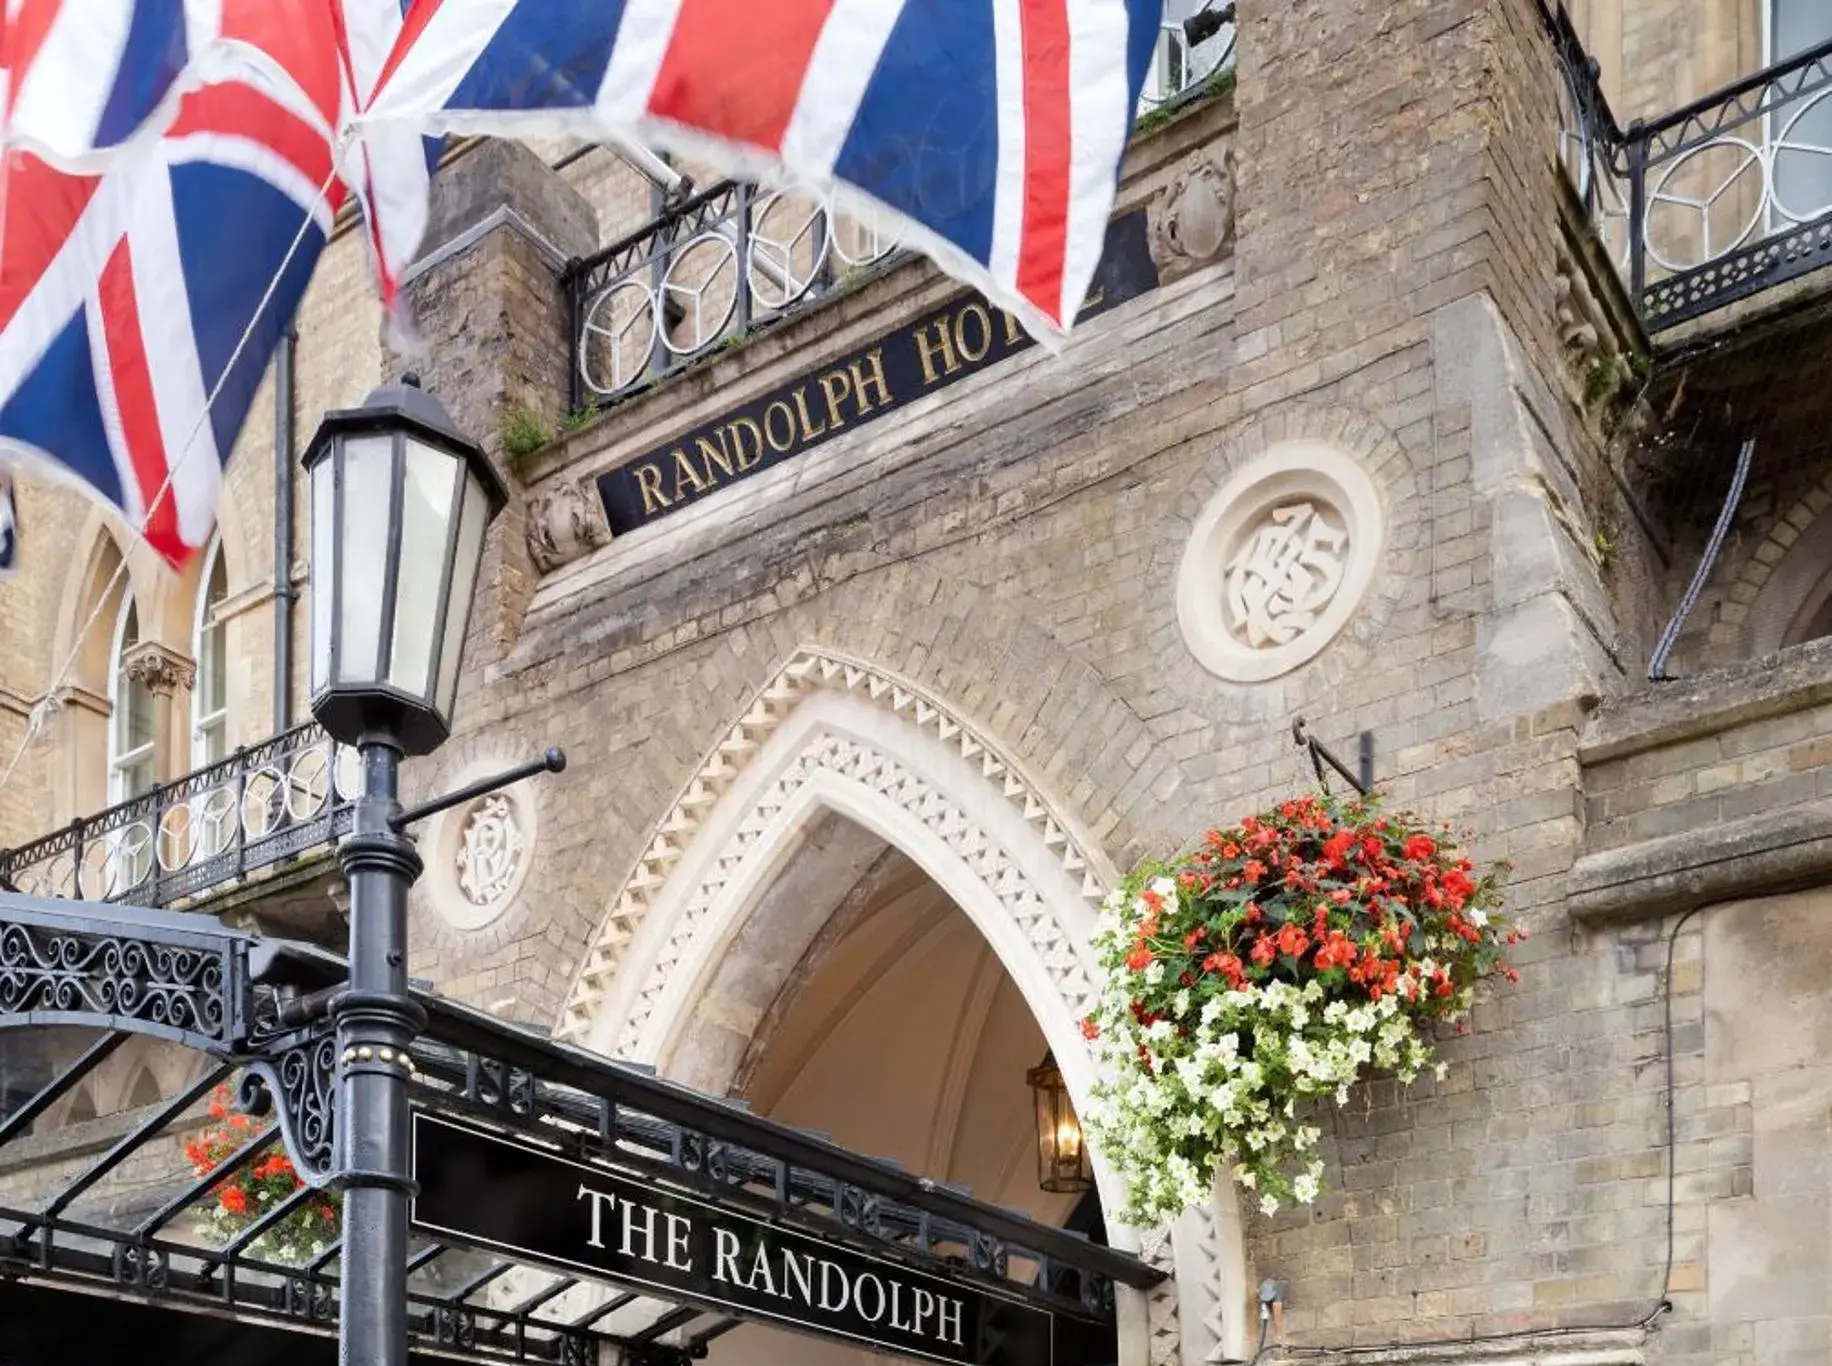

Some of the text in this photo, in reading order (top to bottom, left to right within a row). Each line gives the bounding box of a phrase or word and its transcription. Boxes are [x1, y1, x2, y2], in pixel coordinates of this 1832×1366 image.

[634, 347, 893, 516] RANDOLPH
[576, 1183, 964, 1346] THE RANDOLPH
